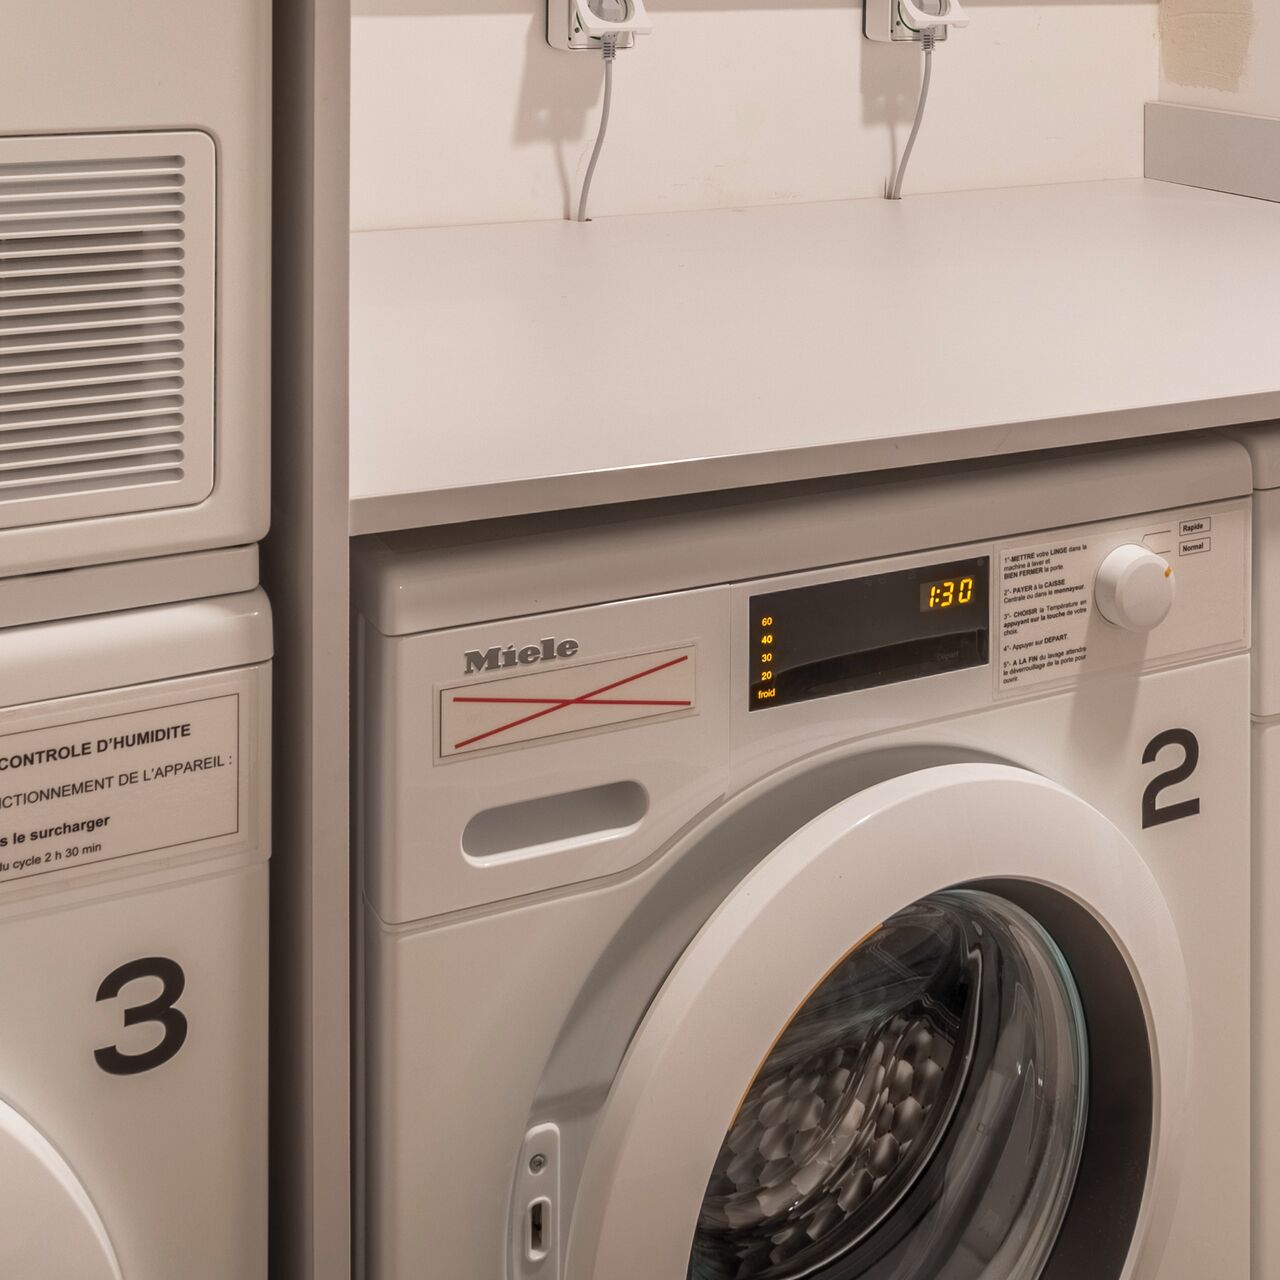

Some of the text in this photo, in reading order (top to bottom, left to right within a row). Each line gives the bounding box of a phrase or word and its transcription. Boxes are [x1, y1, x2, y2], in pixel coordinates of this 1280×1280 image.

[1182, 521, 1204, 533] Rapide
[1182, 541, 1205, 552] Normal
[1004, 570, 1018, 580] BIEN
[1019, 568, 1043, 578] FERMER
[928, 577, 973, 608] 1:30
[761, 617, 773, 626] 60
[761, 635, 773, 644] 40
[464, 637, 579, 674] Miele
[761, 653, 773, 663] 30
[761, 671, 773, 681] 20
[758, 688, 776, 699] froid
[96, 723, 192, 754] D'HUMIDITE
[118, 771, 139, 786] DE
[142, 754, 225, 782] L'APPAREIL
[1142, 727, 1200, 830] 2
[13, 830, 26, 846] le
[30, 815, 111, 842] surcharger
[13, 854, 42, 872] cycle
[45, 852, 52, 863] 2
[55, 850, 62, 861] h
[65, 845, 80, 858] 30
[83, 841, 102, 854] min
[94, 956, 188, 1076] 3
